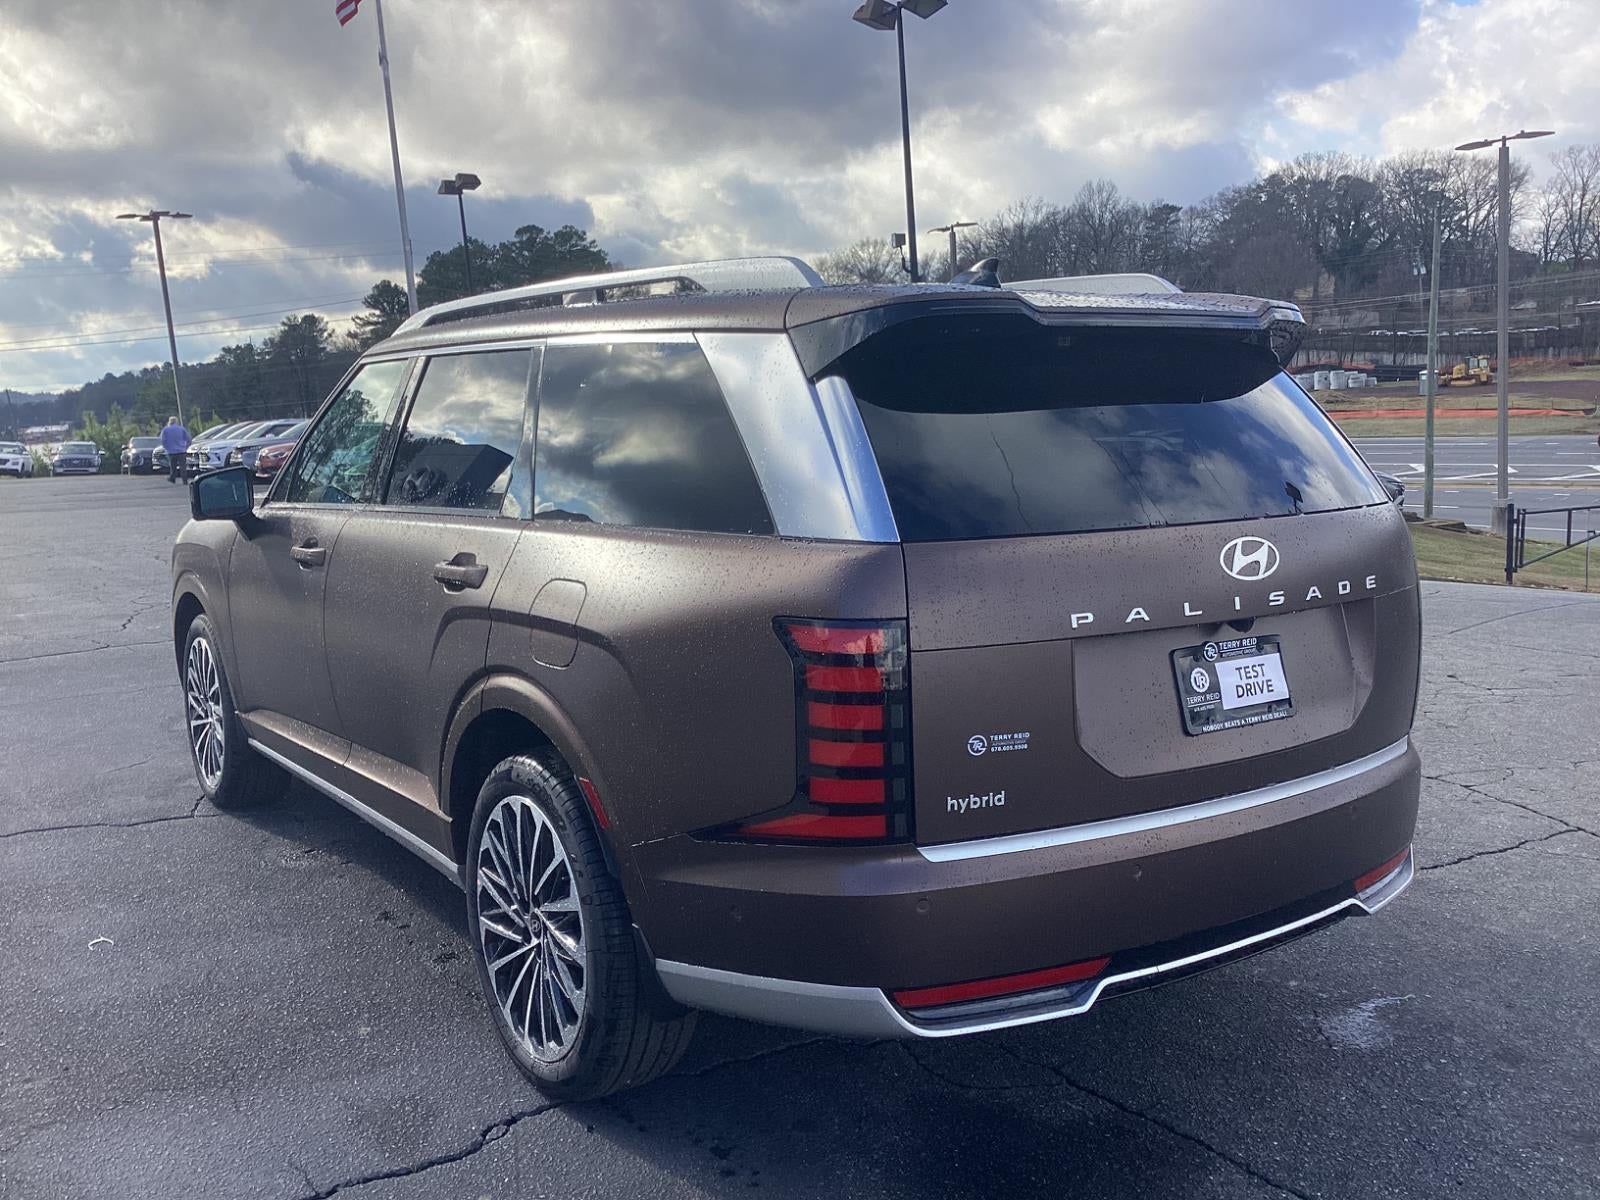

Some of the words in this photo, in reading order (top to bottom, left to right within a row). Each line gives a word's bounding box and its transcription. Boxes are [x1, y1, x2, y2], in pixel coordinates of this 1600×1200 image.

[1071, 575, 1377, 628] PALISADE
[1219, 640, 1241, 651] TERRY
[1242, 637, 1257, 647] REID
[1234, 663, 1265, 681] TEST
[1235, 680, 1275, 698] DRIVE
[1186, 695, 1205, 705] TERRY
[1206, 692, 1220, 701] REID
[1202, 723, 1224, 733] NOBODY
[1224, 719, 1241, 729] BEATS
[1246, 715, 1261, 725] TERRY
[1262, 713, 1274, 721] REID
[947, 790, 1005, 813] hybrid
